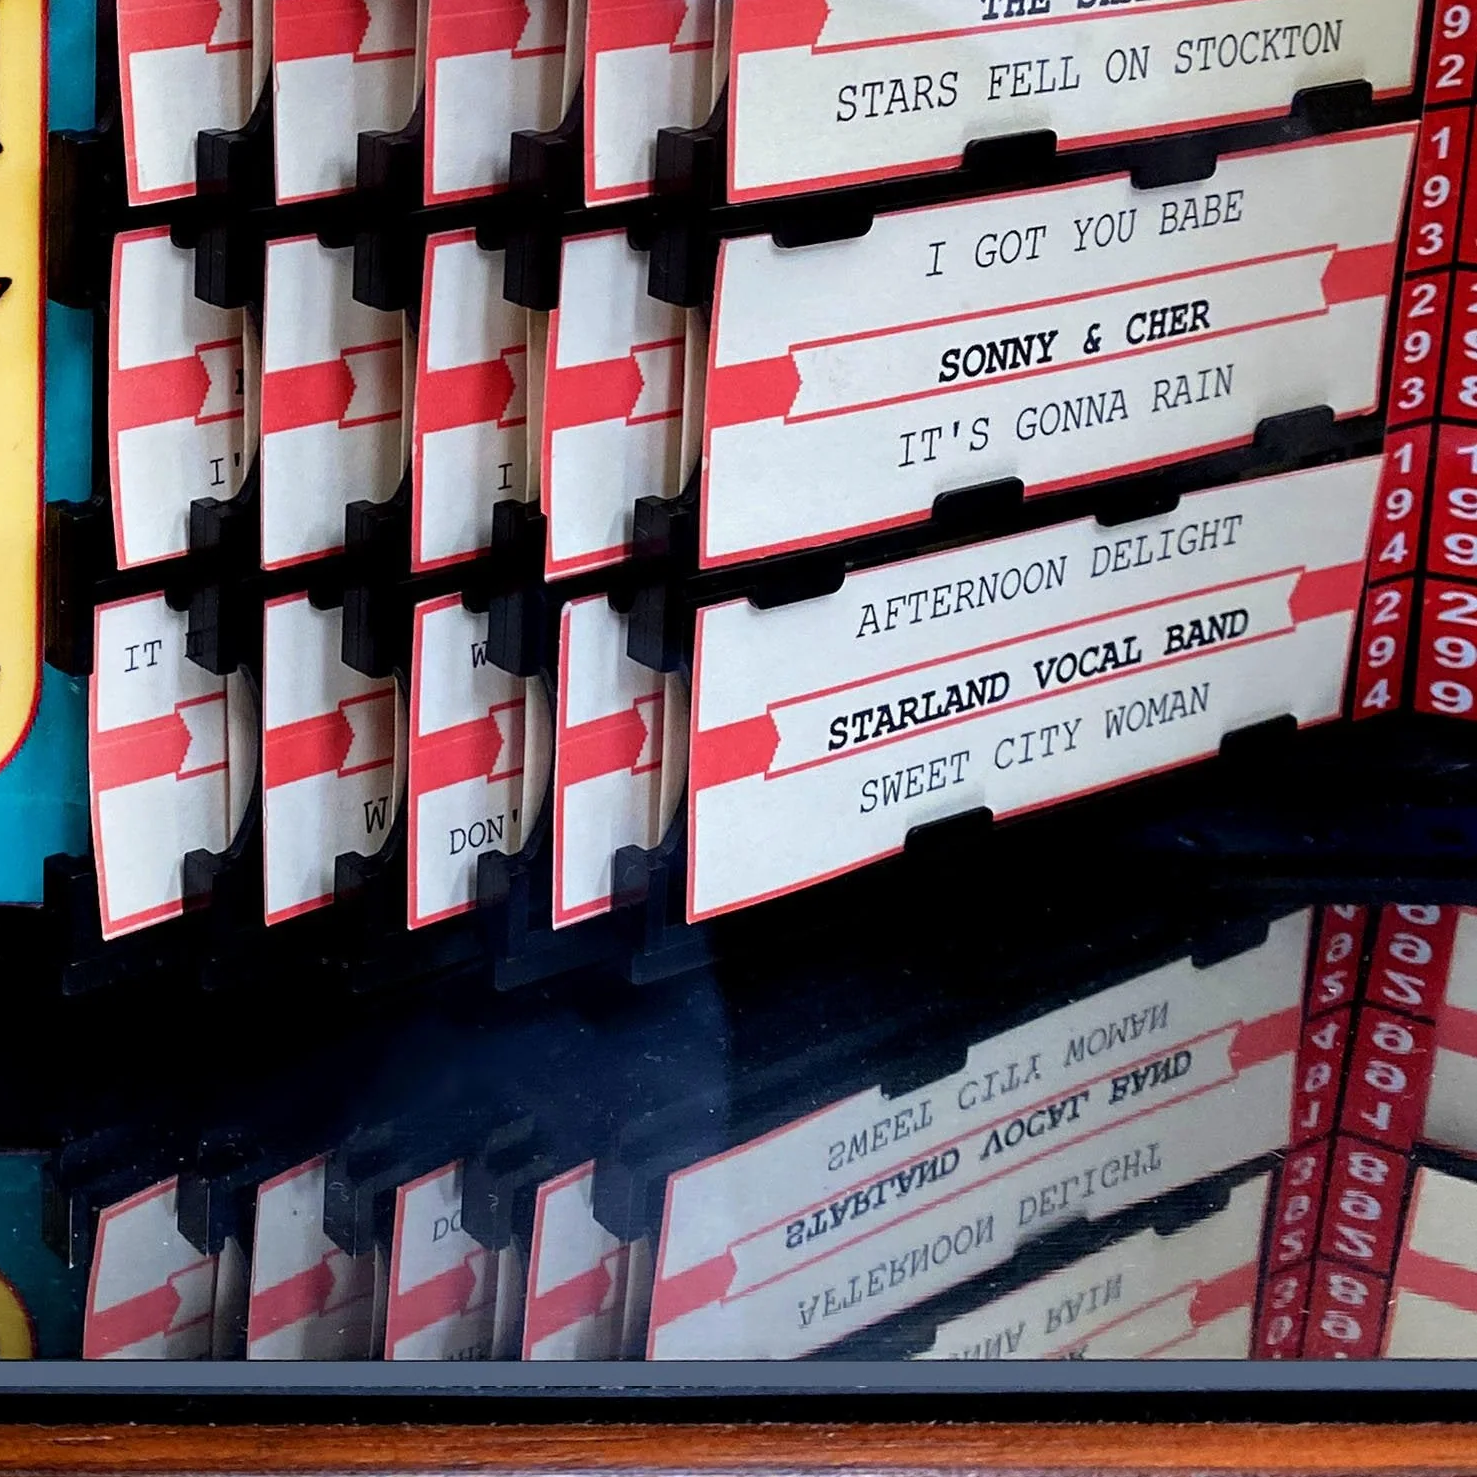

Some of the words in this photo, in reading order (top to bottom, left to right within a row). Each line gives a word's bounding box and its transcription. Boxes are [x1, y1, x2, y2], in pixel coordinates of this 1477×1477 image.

[836, 71, 959, 122] STARS
[987, 55, 1080, 101] FELL
[1105, 45, 1151, 84] ON
[1174, 19, 1344, 74] STOCKTON
[925, 241, 947, 277] I
[975, 225, 1047, 268] GOT
[1073, 208, 1138, 252] YOU
[1158, 189, 1244, 236] BABE
[1417, 126, 1450, 256] 193
[938, 329, 1059, 383] SONNY
[1082, 322, 1102, 355] &
[1125, 299, 1211, 345] CHER
[1398, 283, 1437, 409] 293
[898, 417, 990, 468] IT'S
[1016, 389, 1129, 441] GONNA
[1151, 363, 1234, 413] RAIN
[1379, 442, 1413, 563] 194
[855, 555, 1068, 639] AFTERNOON
[1090, 514, 1243, 578] DELIGHT
[124, 639, 162, 673] IT
[828, 671, 1010, 752] STARLAND
[1033, 635, 1142, 690] VOCAL
[1163, 608, 1249, 656] BAND
[1362, 590, 1402, 709] 294
[1430, 591, 1477, 713] 299
[860, 750, 970, 814] SWEET
[994, 717, 1083, 770] CITY
[1105, 681, 1210, 739] WOMAN
